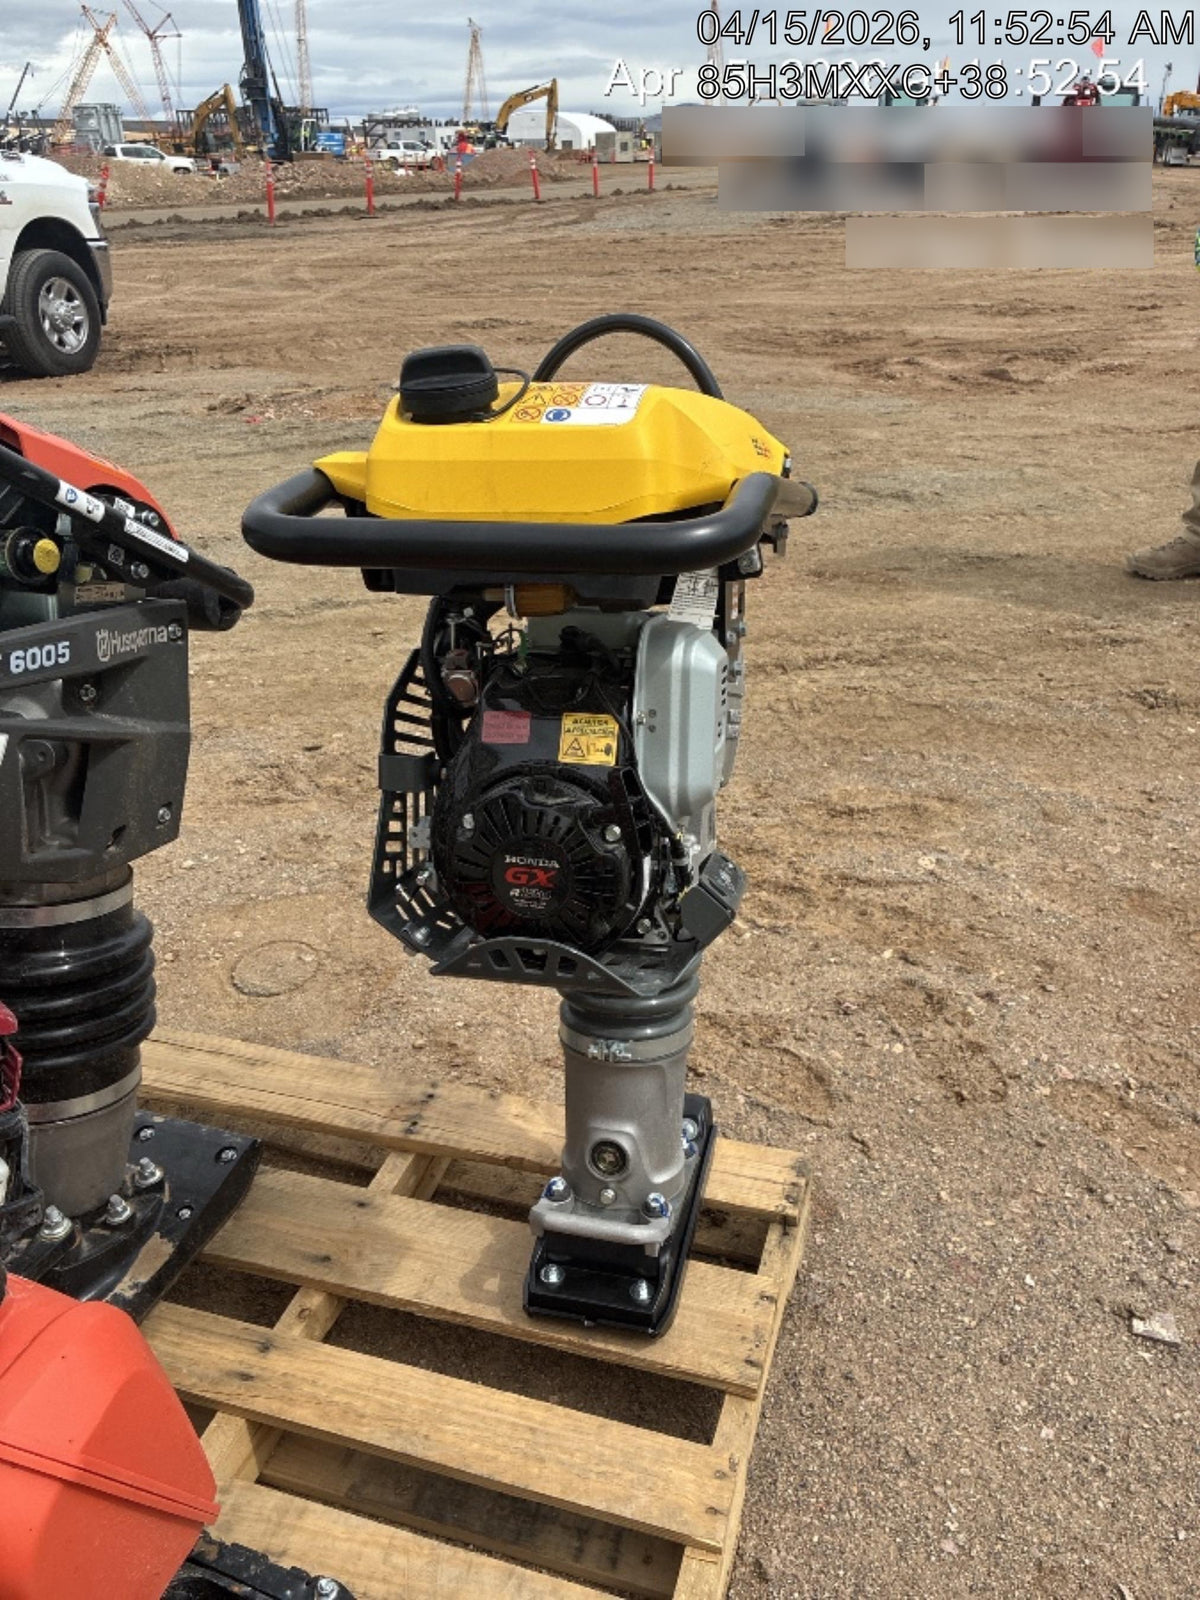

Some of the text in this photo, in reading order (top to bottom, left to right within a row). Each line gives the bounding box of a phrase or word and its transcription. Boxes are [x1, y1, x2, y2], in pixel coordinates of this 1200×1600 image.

[10, 641, 70, 674] 6005
[504, 854, 560, 868] HONDA
[505, 866, 558, 888] GX
